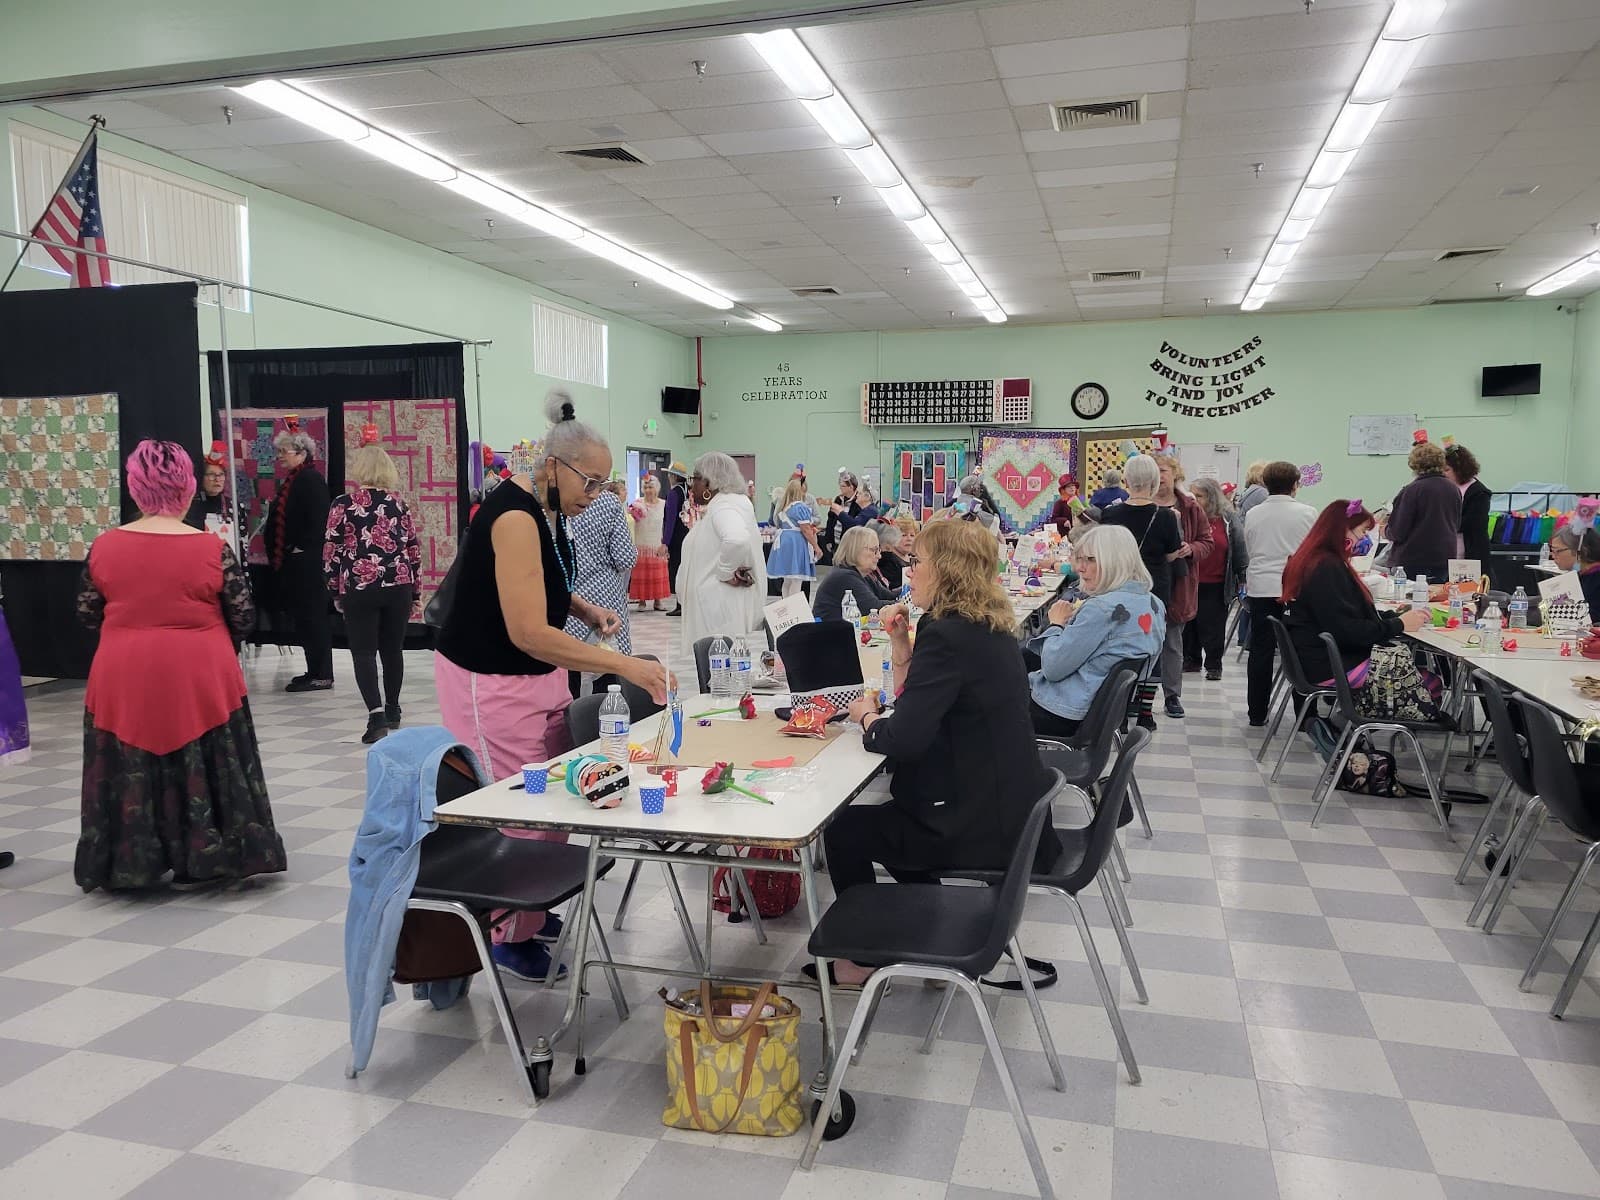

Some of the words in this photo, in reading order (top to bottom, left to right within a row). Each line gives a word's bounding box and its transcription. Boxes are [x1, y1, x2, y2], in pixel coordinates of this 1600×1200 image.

[1159, 335, 1262, 368] VOLUNTEERS
[777, 362, 790, 373] 45
[1150, 358, 1203, 386] BRING
[1211, 355, 1267, 386] LIGHT
[763, 376, 803, 386] YEARS
[741, 390, 828, 402] CELEBRATION
[1145, 389, 1168, 407] TO
[1171, 401, 1205, 417] THE
[1207, 387, 1275, 417] CENTER
[1167, 385, 1205, 401] AND
[1216, 383, 1244, 402] JOY
